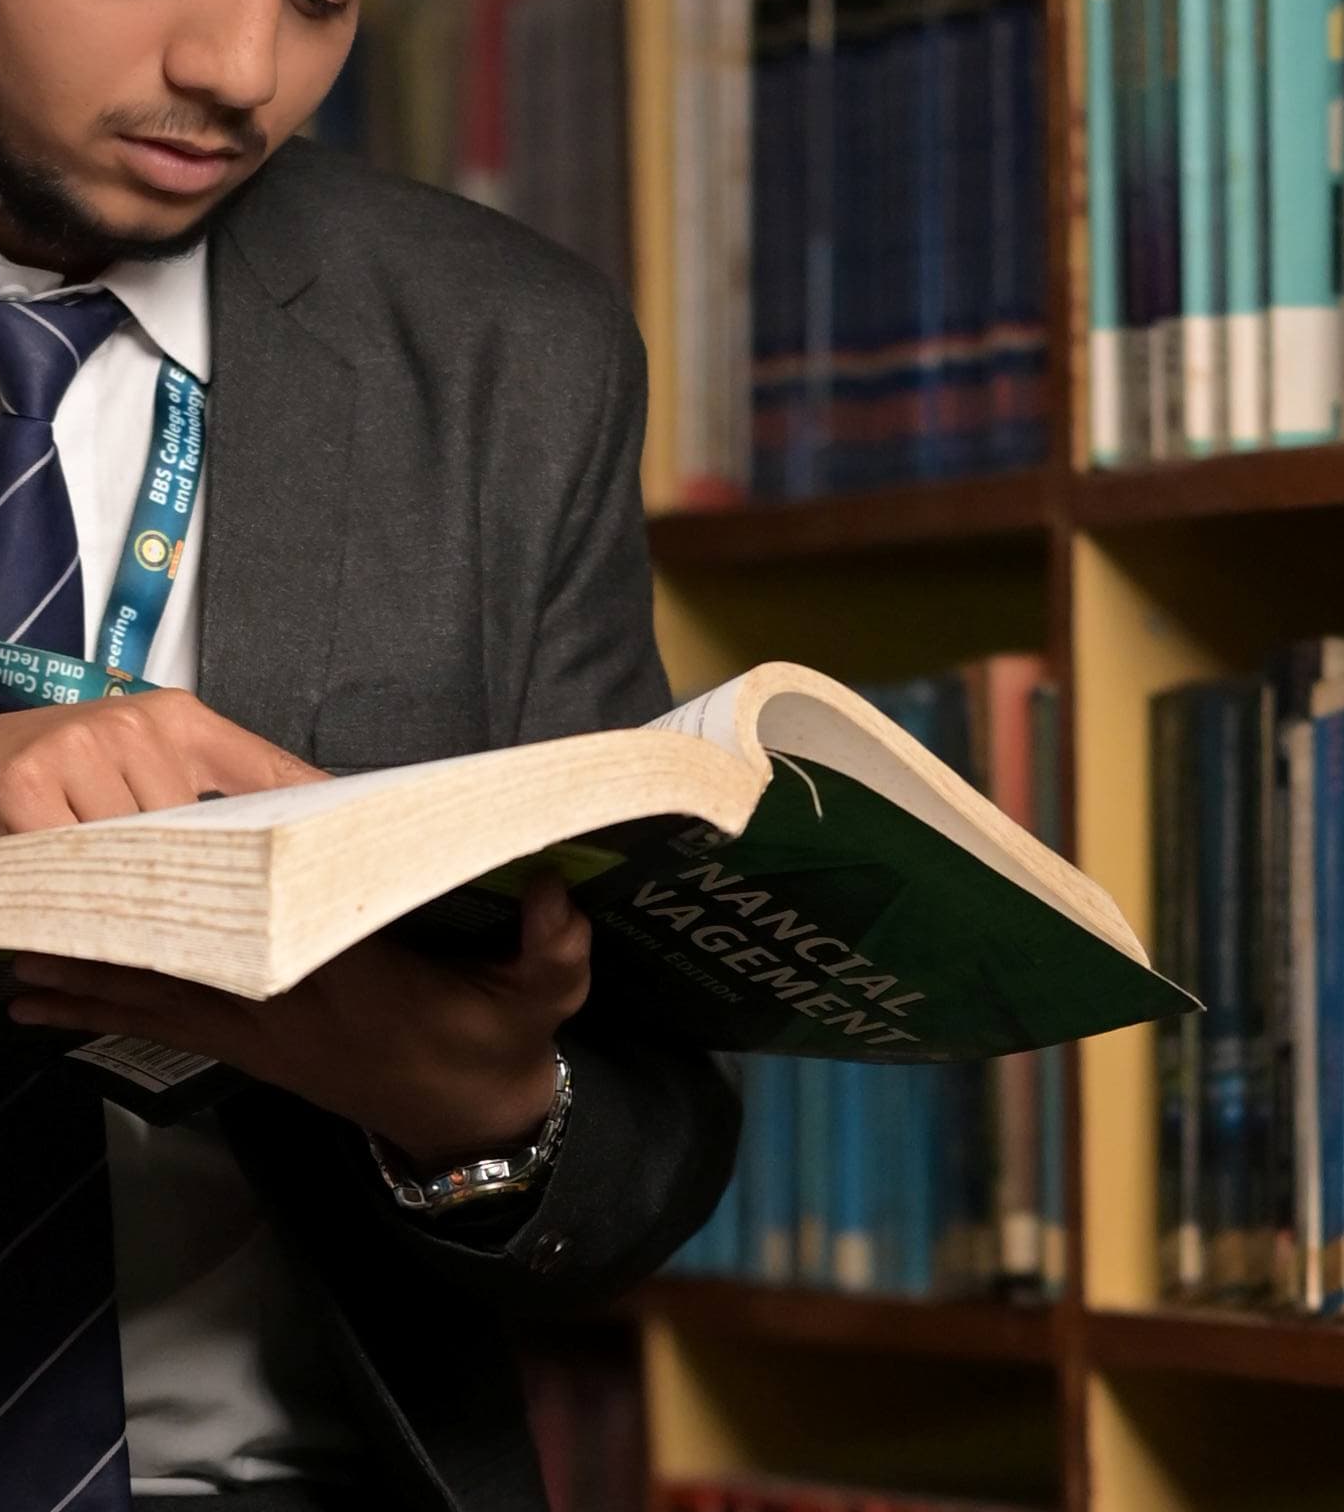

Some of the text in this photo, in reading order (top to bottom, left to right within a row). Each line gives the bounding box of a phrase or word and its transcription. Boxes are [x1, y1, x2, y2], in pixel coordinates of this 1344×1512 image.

[167, 382, 185, 403] of
[159, 402, 190, 466] College
[173, 382, 207, 514] and Technology
[148, 461, 173, 506] BBS
[44, 659, 85, 680] and
[676, 861, 926, 1017] NANCIAL
